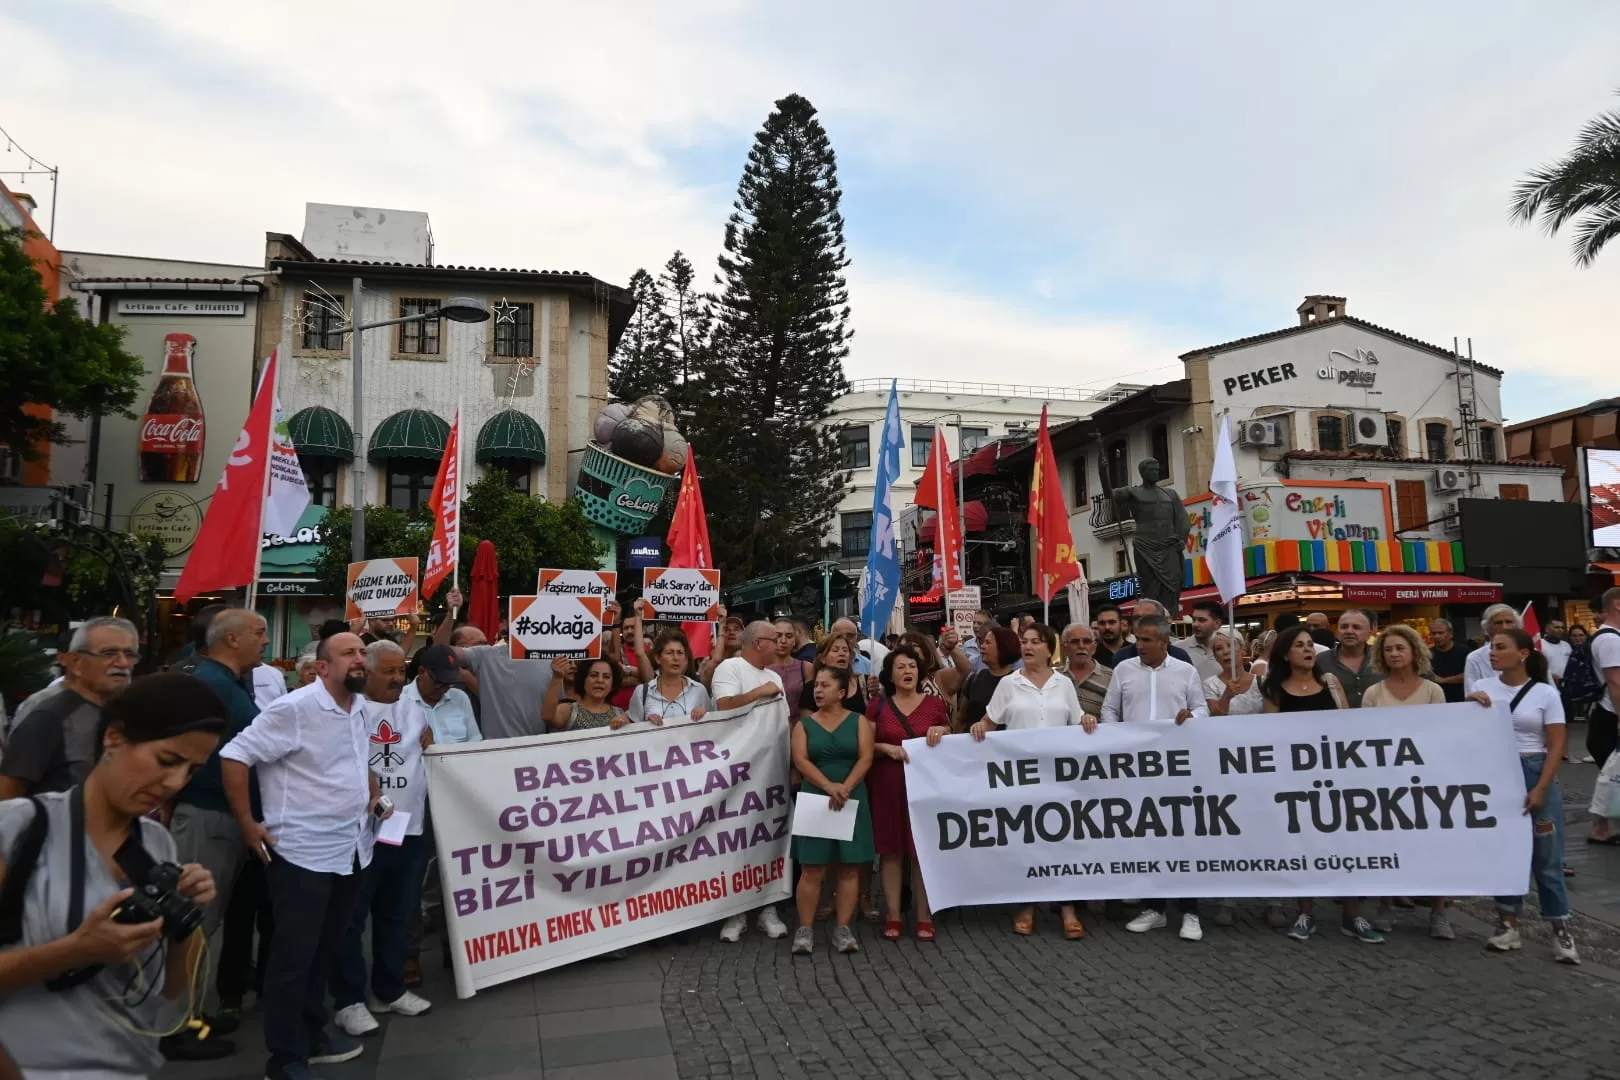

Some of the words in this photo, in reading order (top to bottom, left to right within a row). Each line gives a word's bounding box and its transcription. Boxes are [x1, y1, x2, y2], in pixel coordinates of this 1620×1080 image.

[1223, 363, 1298, 396] PEKER
[142, 418, 203, 442] Coca-Cola
[352, 589, 374, 603] OMUZ
[376, 586, 411, 599] OMUZA!
[544, 580, 586, 596] faşizme
[587, 581, 611, 598] karşı
[649, 579, 668, 589] Halk
[515, 614, 594, 640] #sokağa
[513, 739, 731, 792] BASKILAR,
[987, 758, 1041, 789] NE
[1054, 749, 1192, 783] DARBE
[1219, 745, 1276, 775] NE
[1290, 735, 1425, 772] DİKTA
[498, 761, 751, 832] GÖZALTILAR
[937, 785, 1241, 851] DEMOKRATİK
[1274, 775, 1497, 834] TÜRKİYE
[451, 784, 787, 876] TUTUKLAMALAR
[453, 868, 535, 917] BİZİ
[552, 815, 790, 893] YILDIRAMAZ
[1026, 861, 1105, 879] ANTALYA
[1110, 860, 1161, 875] EMEK
[1165, 859, 1190, 873] VE
[1196, 855, 1308, 873] DEMOKRASİ
[1314, 852, 1400, 874] GÜÇLERİ
[546, 909, 595, 944] EMEK
[598, 902, 623, 929] VE
[626, 871, 728, 922] DEMOKRASİ
